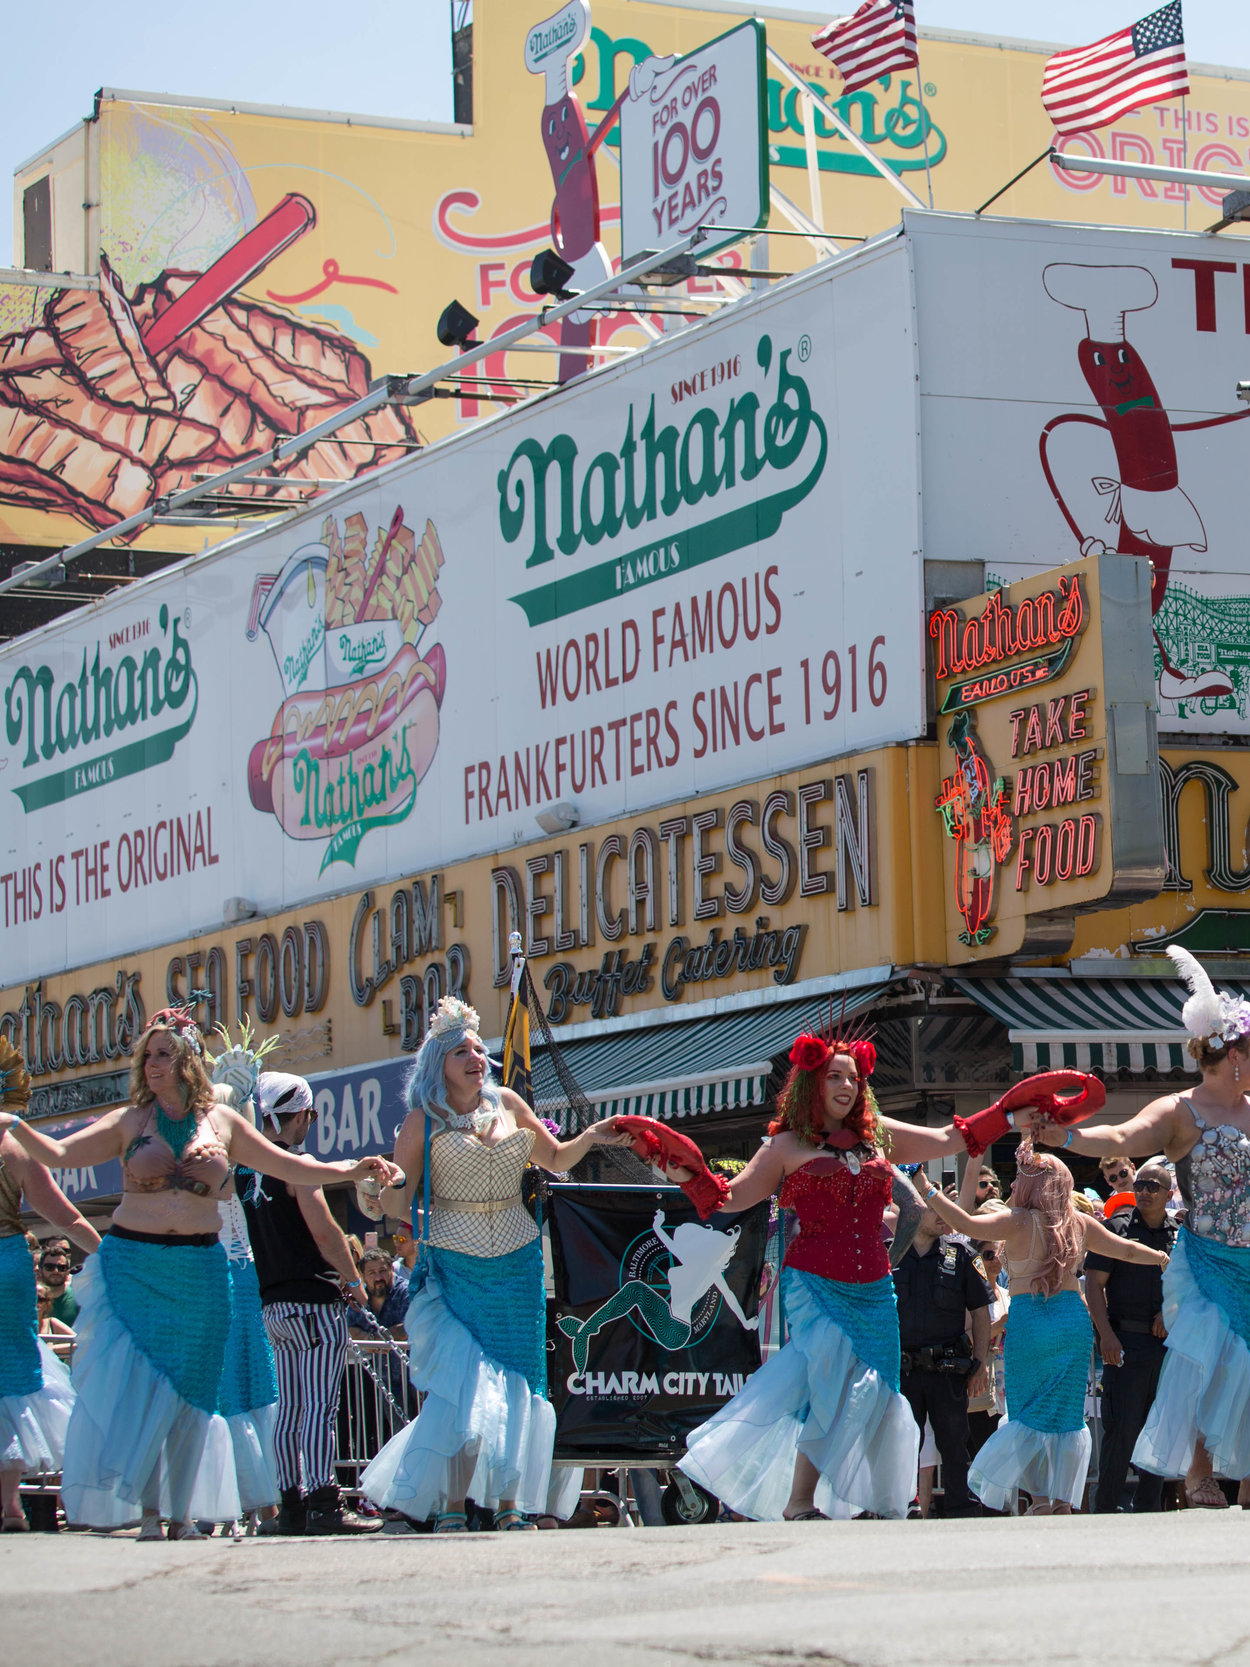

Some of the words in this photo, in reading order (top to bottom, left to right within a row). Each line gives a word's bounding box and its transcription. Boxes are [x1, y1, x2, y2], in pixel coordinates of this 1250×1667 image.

[652, 97, 678, 134] FOR
[681, 64, 718, 108] OVER
[1153, 106, 1219, 134] THIS
[1228, 115, 1249, 137] IS
[652, 96, 721, 199] 100
[652, 158, 723, 237] YEARS
[671, 367, 709, 405] SINCE
[709, 353, 742, 391] 1916
[498, 334, 812, 569] Nathan's
[615, 541, 680, 591] FAMOUS
[536, 618, 640, 709] WORLD
[651, 564, 782, 673] FAMOUS
[929, 574, 1085, 680] Nathan's
[5, 603, 192, 768] Nathan's
[463, 699, 680, 825] FRANKFURTERS
[693, 667, 785, 759] SINCE
[800, 635, 888, 726] 1916
[1009, 690, 1091, 758] TAKE
[75, 757, 114, 791] FAMOUS
[293, 725, 411, 829] Nathan's
[1014, 748, 1097, 817] HOME
[0, 861, 43, 928] THIS
[50, 855, 66, 915] IS
[71, 840, 111, 907] THE
[117, 806, 219, 893] ORIGINAL
[491, 768, 876, 989] DELICATESSEN
[1015, 813, 1097, 892] FOOD
[236, 919, 331, 1029] FOOD
[349, 873, 444, 1008] CLAM
[543, 943, 656, 1025] Buffet
[661, 917, 808, 1001] Catering
[400, 943, 470, 1051] BAR
[315, 1077, 385, 1156] BAR
[628, 1236, 659, 1280] BALTIMORE
[692, 1290, 719, 1335] MARYLAND
[566, 1371, 660, 1396] CHARM
[663, 1371, 710, 1396] CITY
